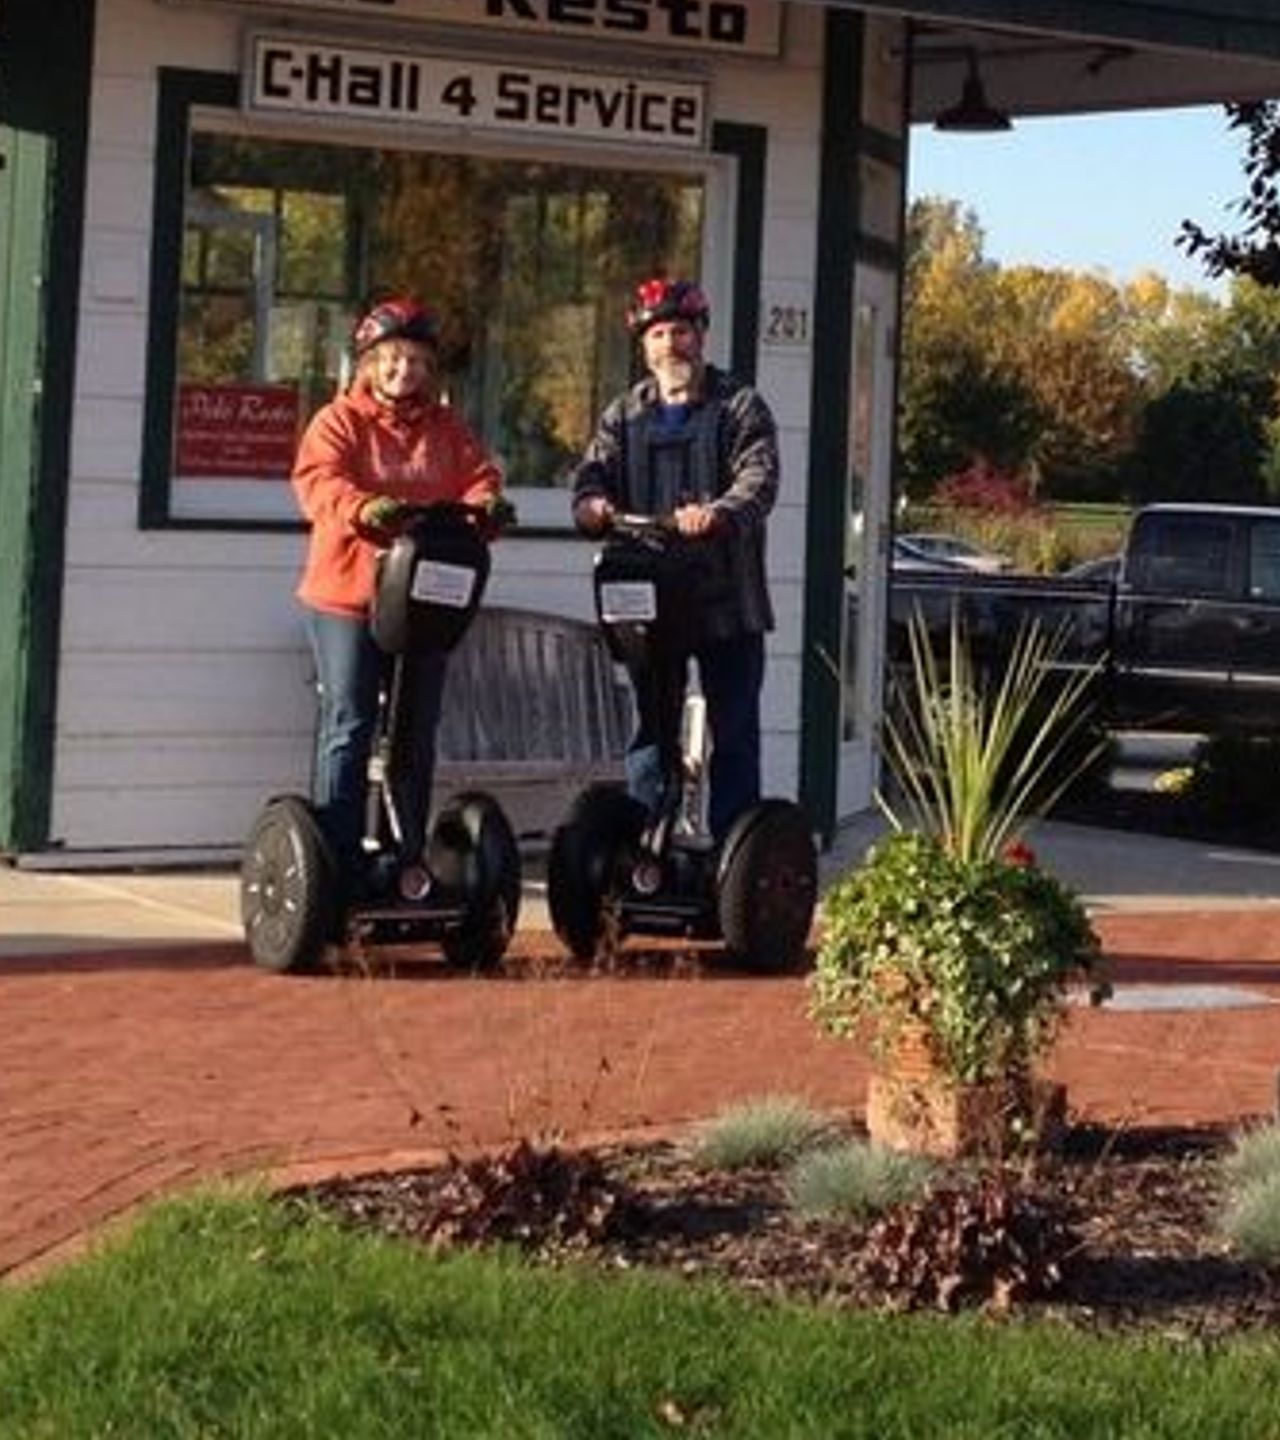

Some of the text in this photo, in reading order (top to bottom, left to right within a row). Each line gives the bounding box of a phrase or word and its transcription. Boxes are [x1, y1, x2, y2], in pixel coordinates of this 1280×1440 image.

[262, 49, 696, 136] C-Hall 4 Service
